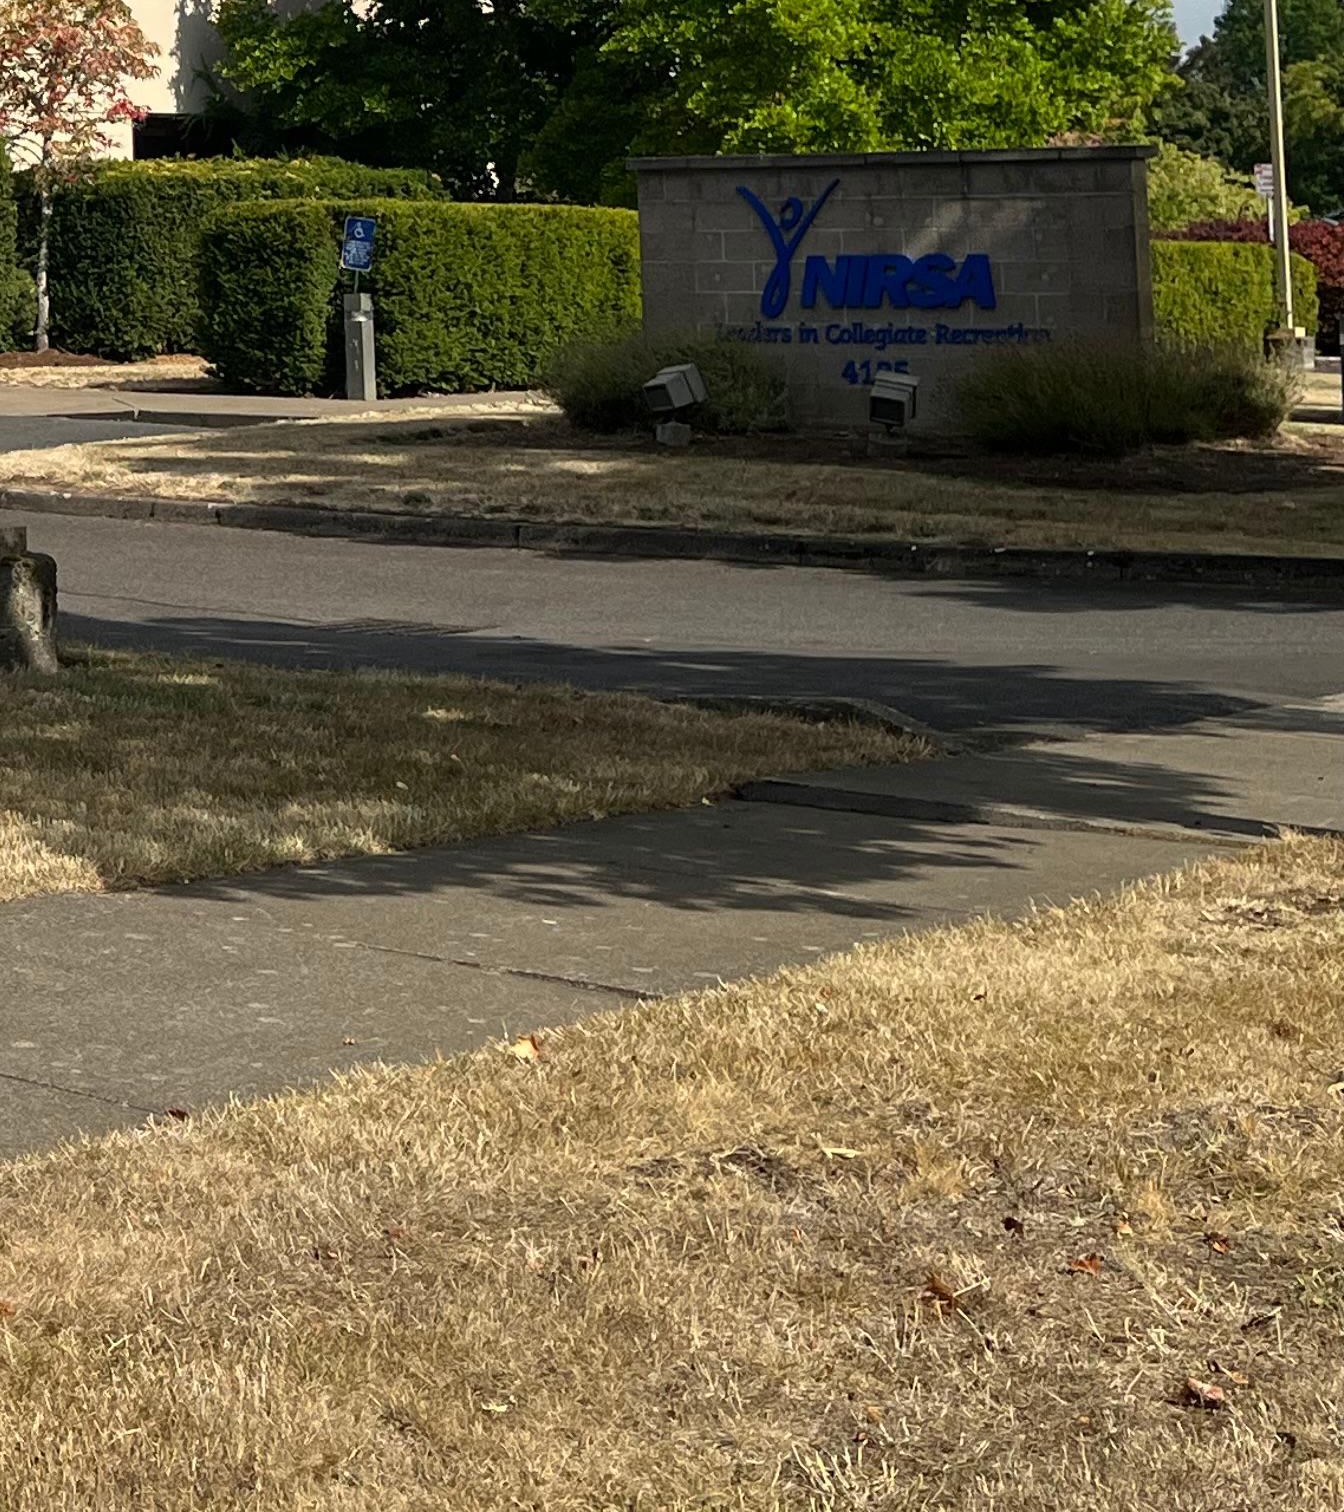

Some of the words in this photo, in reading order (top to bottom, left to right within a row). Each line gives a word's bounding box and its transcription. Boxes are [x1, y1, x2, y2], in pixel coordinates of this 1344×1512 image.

[800, 254, 997, 309] NIRSA
[795, 321, 820, 344] in
[825, 322, 927, 349] Collegiate
